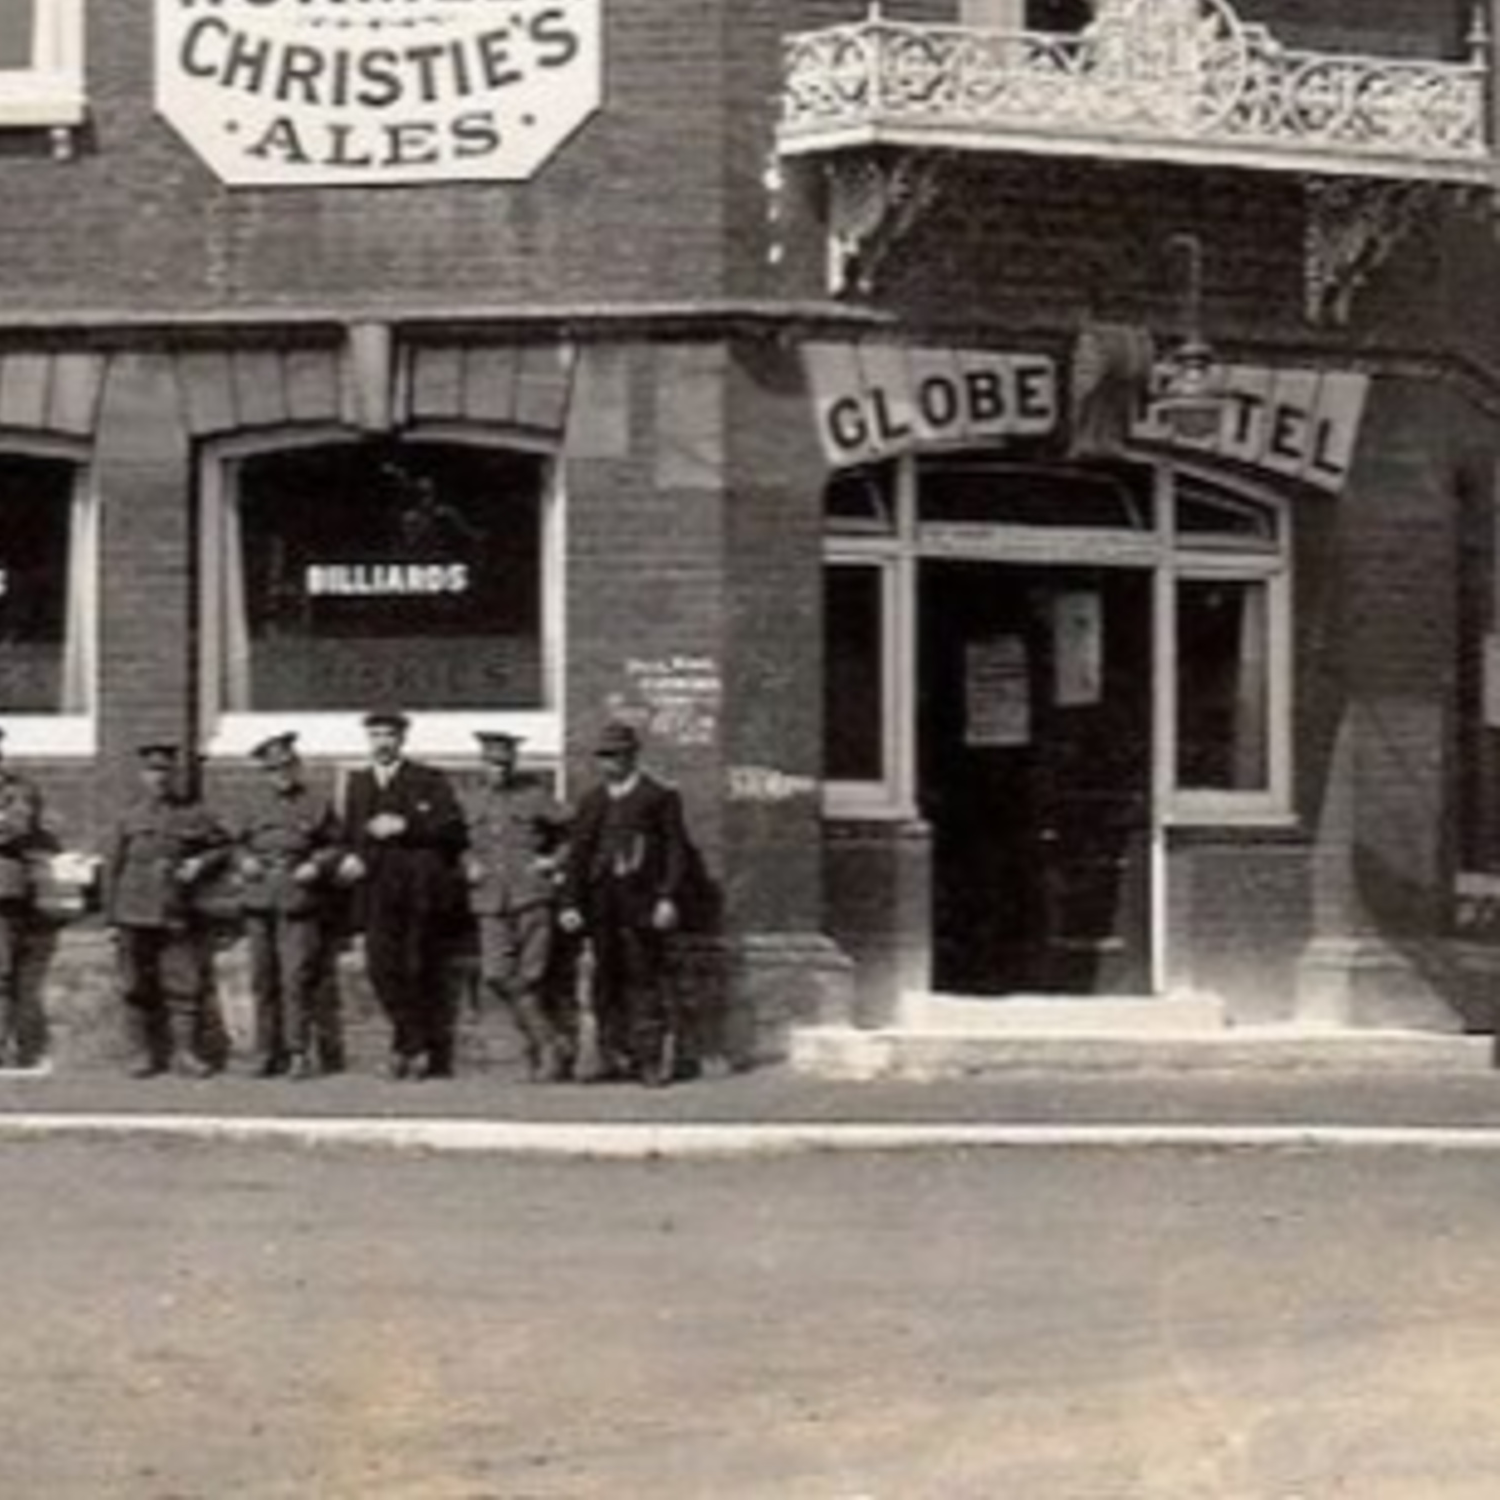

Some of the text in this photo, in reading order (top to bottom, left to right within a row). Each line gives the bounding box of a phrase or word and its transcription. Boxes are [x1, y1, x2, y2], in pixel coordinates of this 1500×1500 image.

[179, 9, 579, 107] CHRISTIE'S
[244, 111, 500, 166] ALES
[827, 366, 1344, 476] GLOBE HTEL
[307, 564, 468, 595] BILLIARDS
